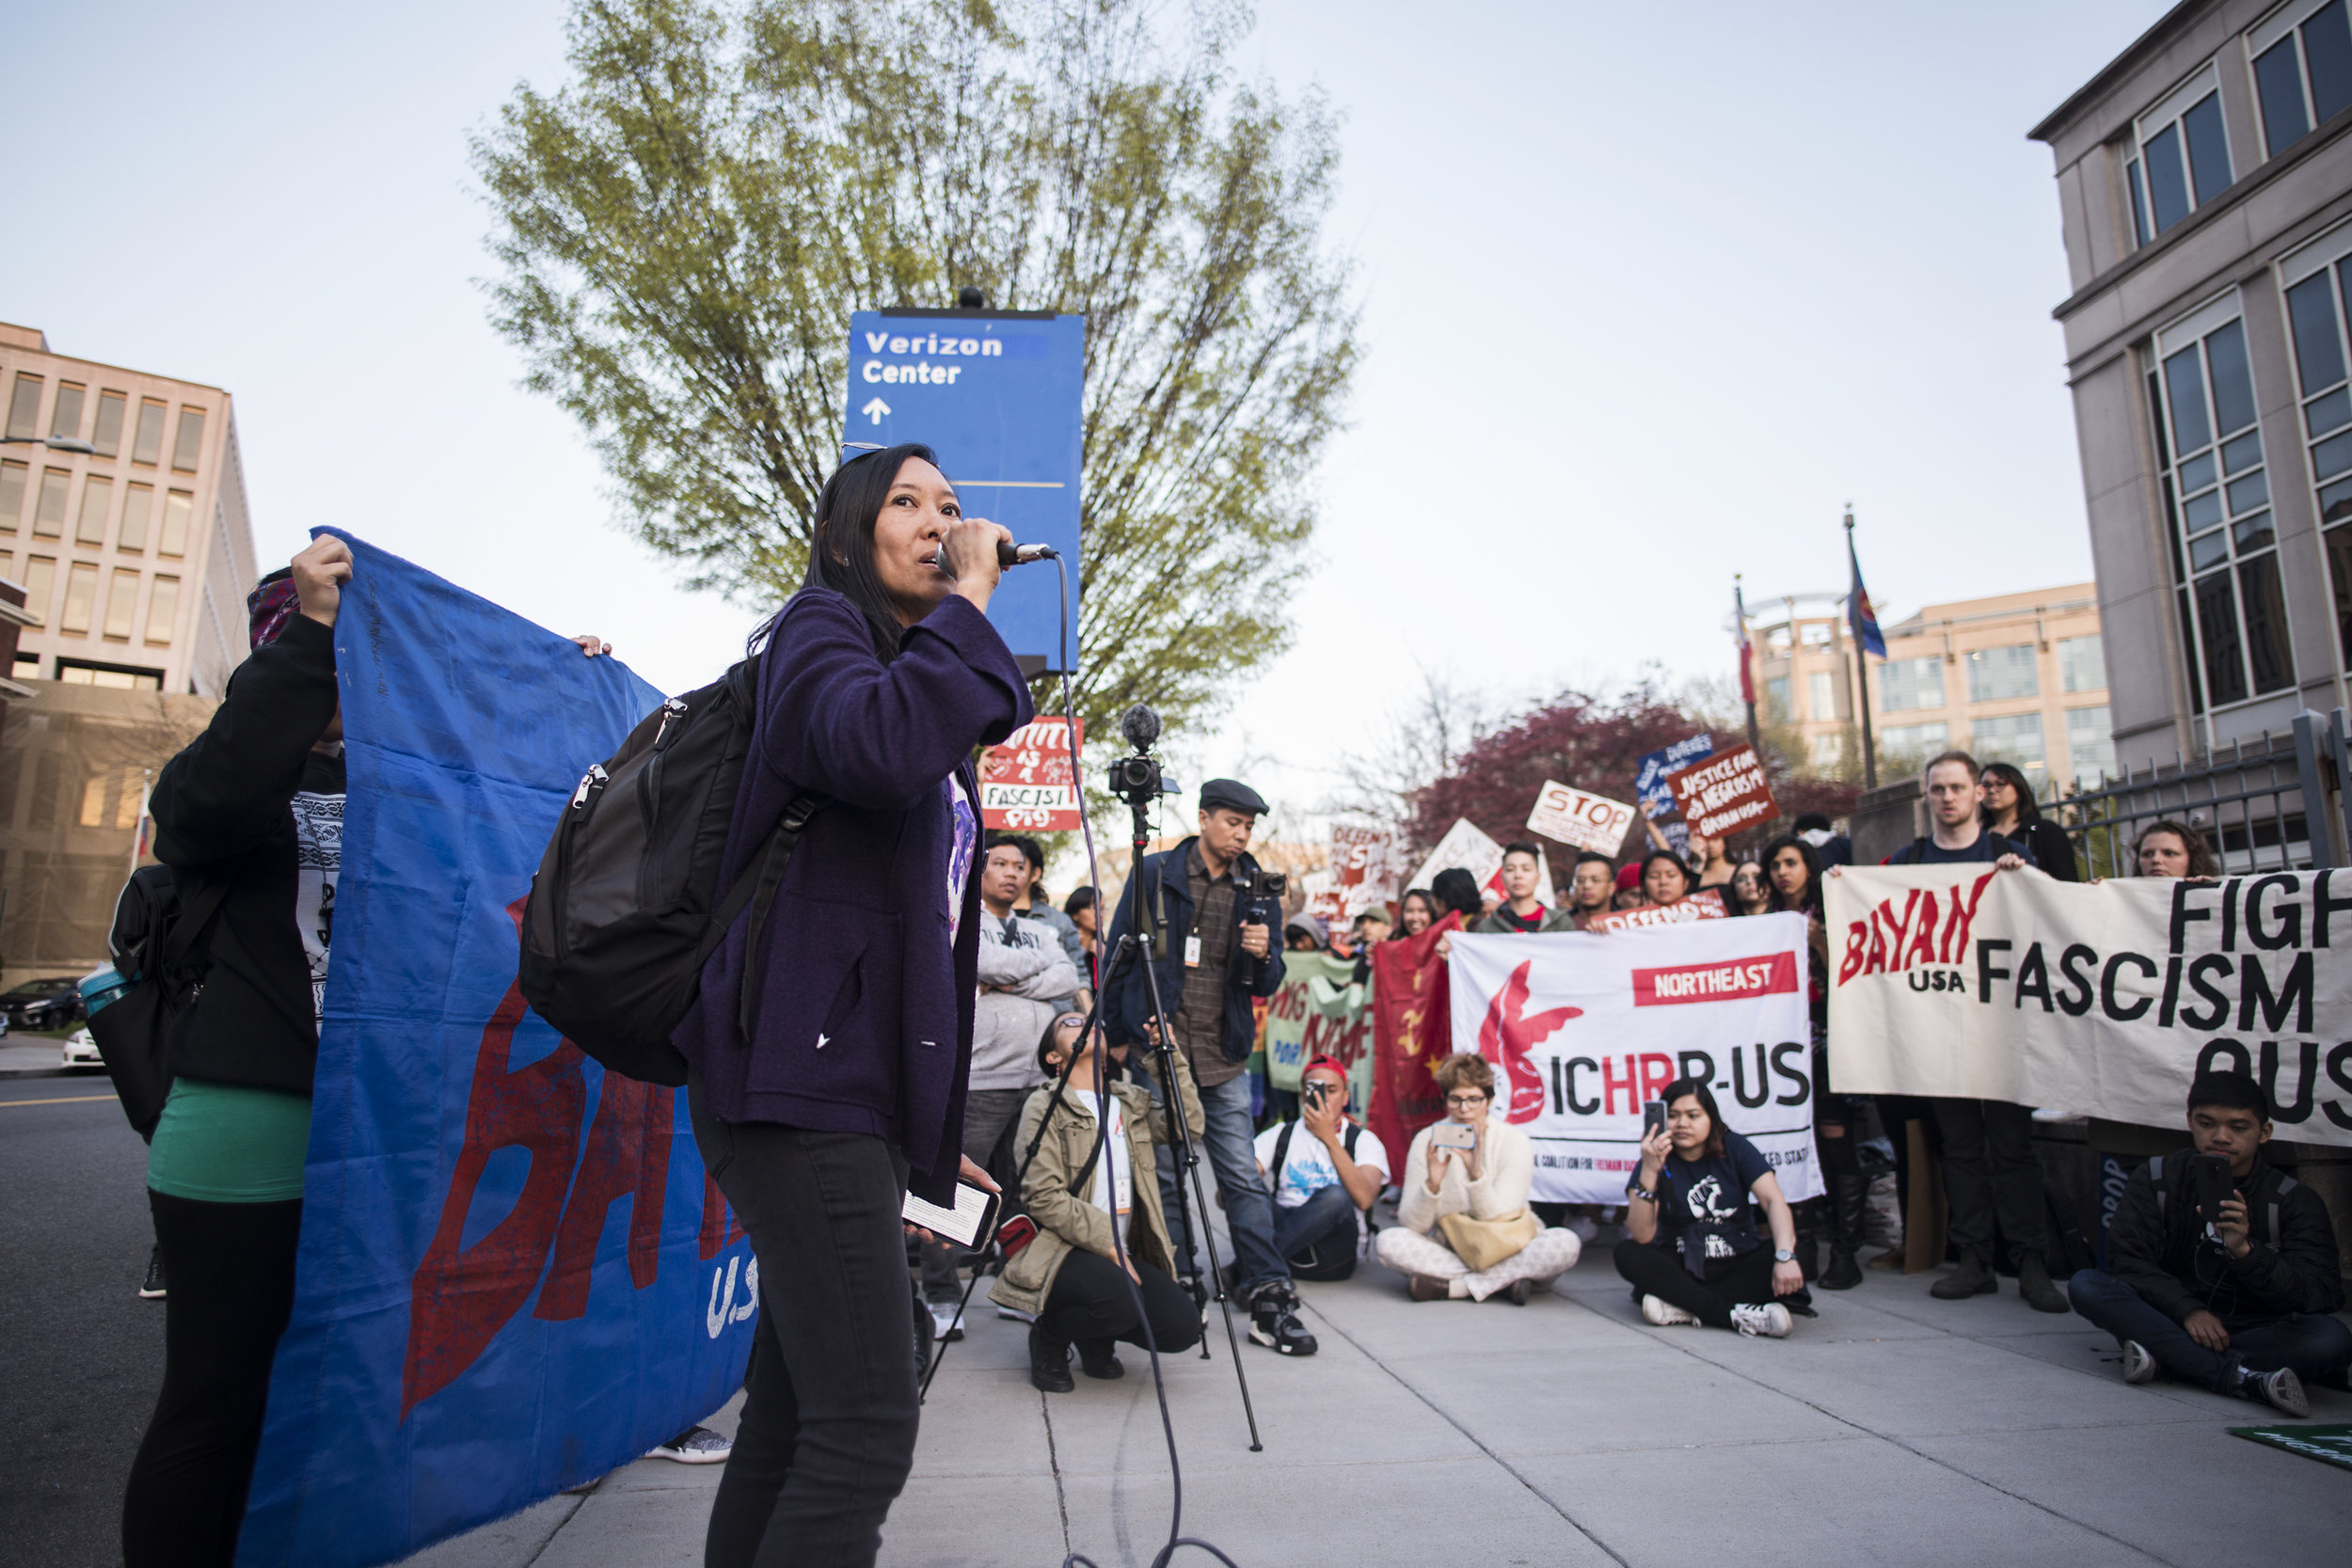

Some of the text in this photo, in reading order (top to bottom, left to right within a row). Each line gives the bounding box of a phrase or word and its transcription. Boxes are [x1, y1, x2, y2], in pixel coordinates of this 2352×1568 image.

[865, 332, 1003, 356] Verizon
[862, 360, 961, 386] Center
[1678, 758, 1737, 800] JUSTICE
[1733, 750, 1757, 773] FOR
[1545, 790, 1628, 831] STOP
[1700, 809, 1740, 837] BAYAN
[1605, 902, 1701, 930] DEFEND
[1837, 872, 1996, 989] BAYAN
[1654, 962, 1773, 998] NORTHEAST
[1909, 971, 1965, 993] USA
[1978, 939, 2314, 1034] FASCISM
[1785, 1148, 1808, 1165] STAT
